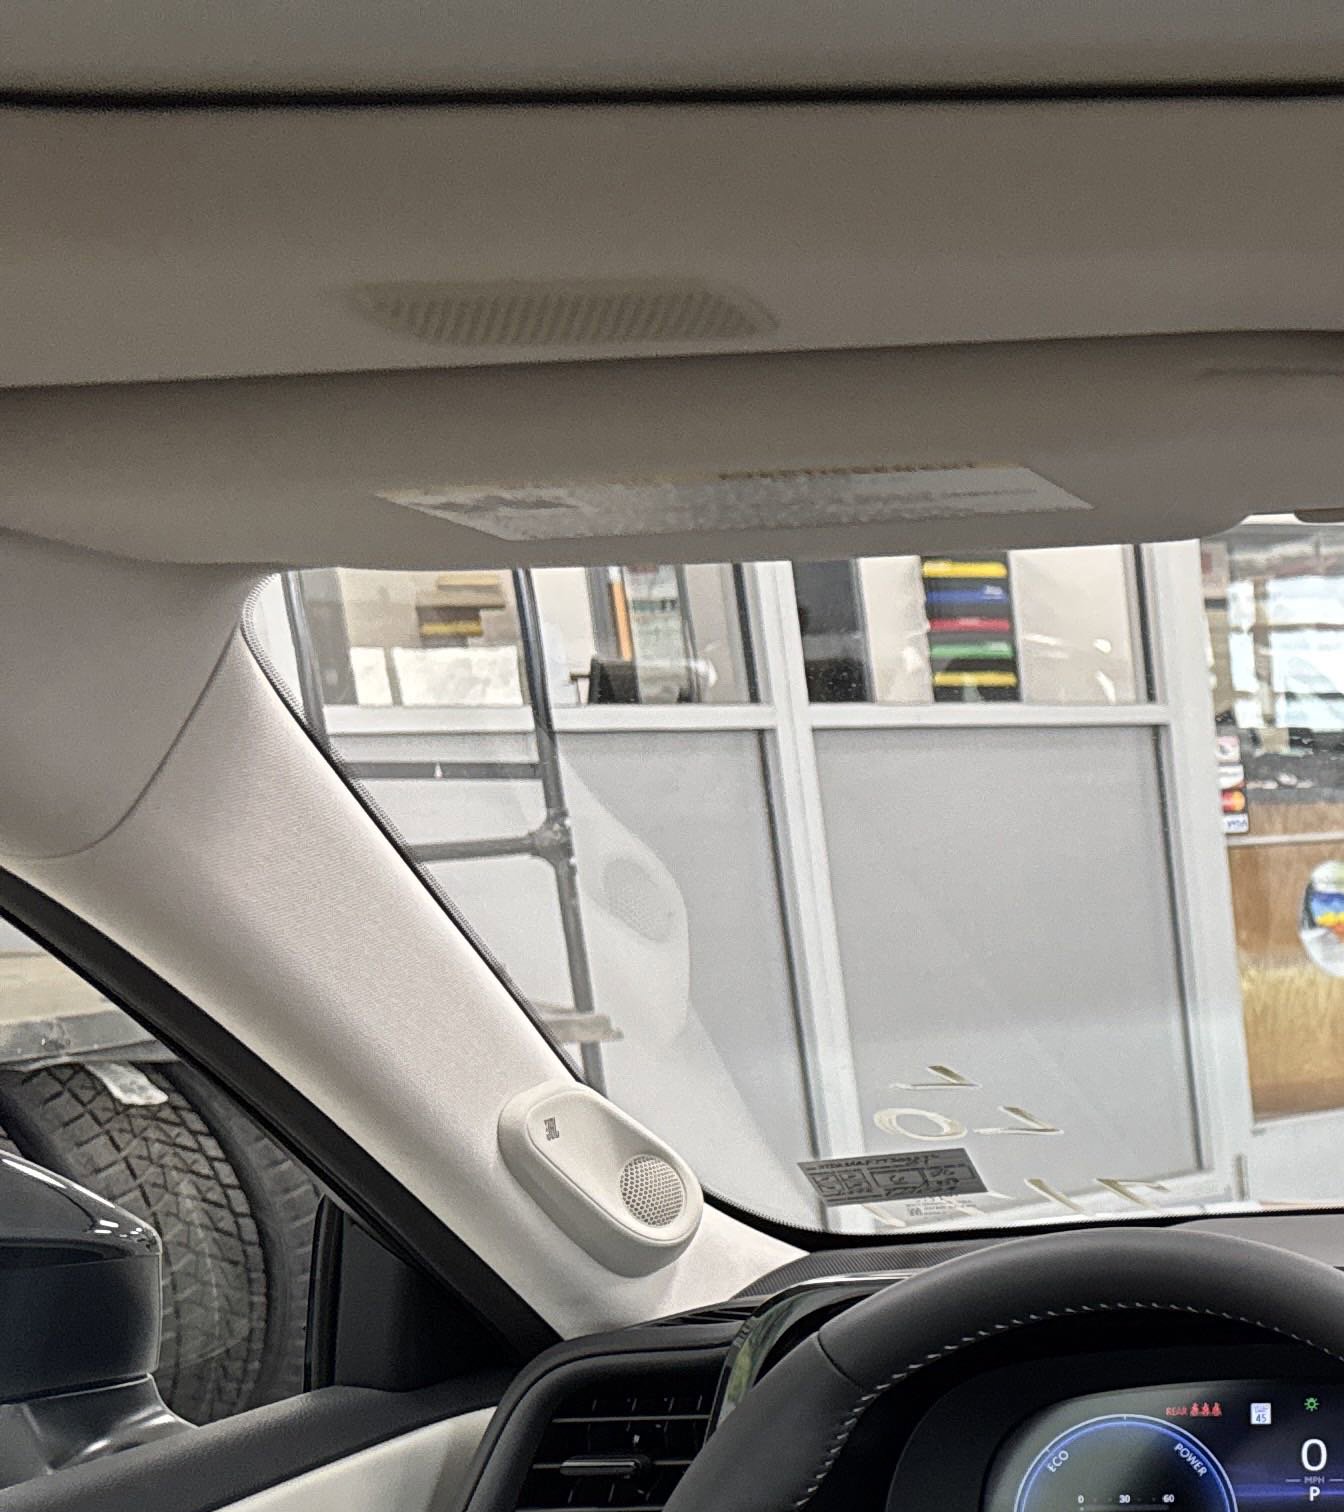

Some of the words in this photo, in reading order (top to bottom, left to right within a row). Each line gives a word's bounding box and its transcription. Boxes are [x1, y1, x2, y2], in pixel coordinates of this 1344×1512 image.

[1047, 1450, 1070, 1473] ECO
[1174, 1442, 1208, 1477] POWER
[1301, 1438, 1328, 1472] 0
[1304, 1476, 1325, 1484] MPH
[1077, 1495, 1085, 1505] 0
[1119, 1495, 1131, 1505] 30
[1163, 1494, 1175, 1504] 60
[1309, 1486, 1321, 1502] P
